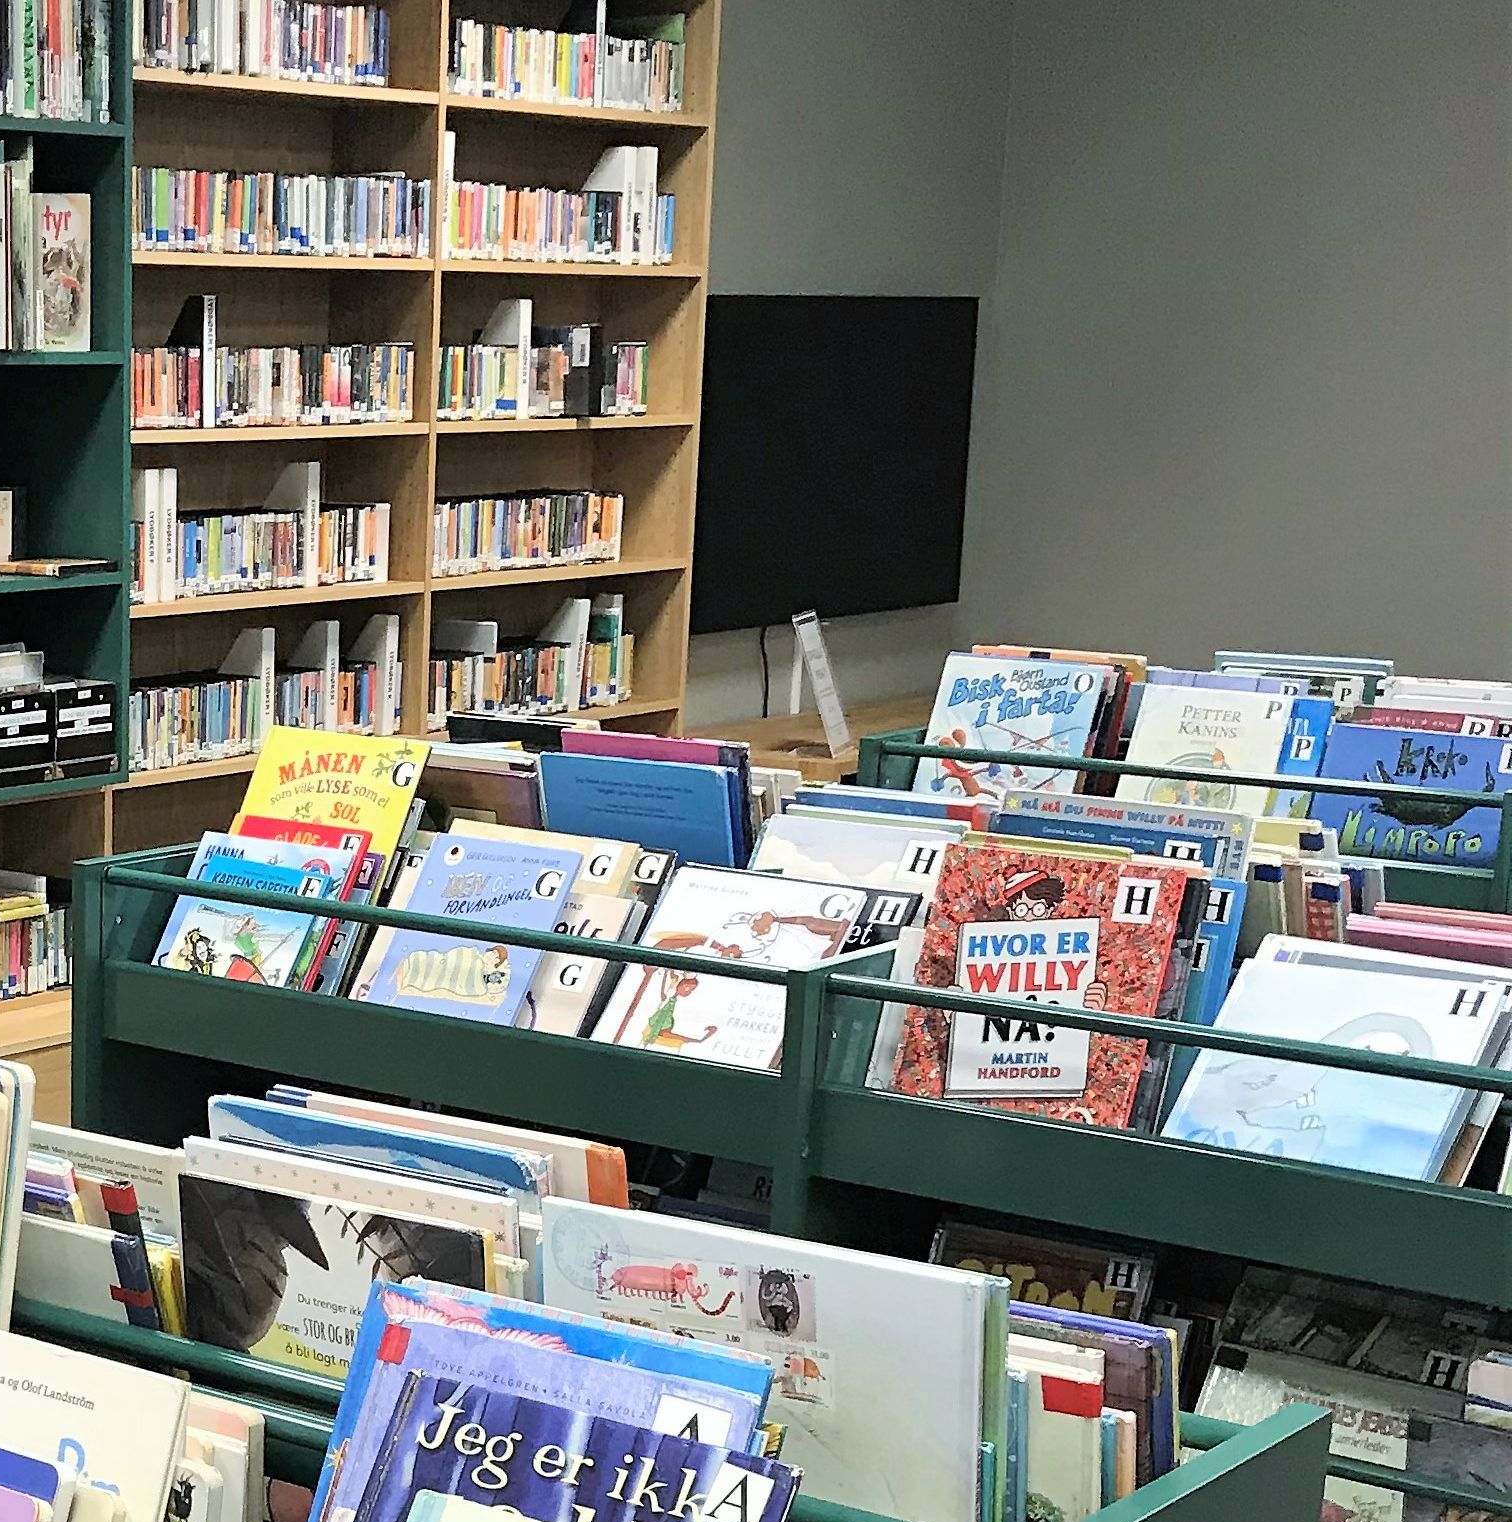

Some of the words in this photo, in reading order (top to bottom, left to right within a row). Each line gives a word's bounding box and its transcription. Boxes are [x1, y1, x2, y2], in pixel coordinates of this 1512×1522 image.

[947, 673, 1006, 707] Bisk
[1074, 673, 1094, 694] O
[1341, 687, 1352, 701] P
[975, 702, 990, 728] i
[997, 689, 1082, 723] farta!
[1181, 705, 1241, 723] PETTER
[1265, 700, 1283, 719] P
[1178, 721, 1238, 738] KANINS
[1295, 738, 1311, 759] P
[278, 749, 367, 786] MÅNEN
[392, 761, 417, 788] G
[270, 789, 292, 805] som
[316, 779, 352, 795] LYSE
[353, 786, 378, 802] som
[329, 801, 361, 825] SOL
[588, 854, 611, 877] G
[633, 854, 660, 880] G
[907, 847, 940, 875] H
[535, 870, 563, 897] G
[819, 893, 851, 919] G
[874, 900, 901, 922] H
[1123, 885, 1154, 916] H
[967, 932, 1048, 958] HVOR
[1056, 931, 1091, 954] ER
[559, 963, 583, 986] G
[966, 959, 1088, 993] WILLY
[1449, 988, 1489, 1018] H
[991, 1051, 1049, 1065] MARTIN
[977, 1066, 1061, 1080] HANDFORD
[1110, 1260, 1134, 1289] H
[297, 1293, 310, 1305] Du
[313, 1298, 348, 1314] trenger
[349, 1304, 364, 1318] ikk
[303, 1317, 327, 1341] STOR
[328, 1323, 343, 1345] OG
[296, 1344, 309, 1358] bli
[313, 1348, 336, 1367] lagt
[1425, 1355, 1462, 1391] H
[7, 1375, 19, 1392] og
[21, 1379, 43, 1395] Olof
[43, 1384, 95, 1412] Landström
[414, 1400, 523, 1491] Jeg
[532, 1443, 595, 1487] er
